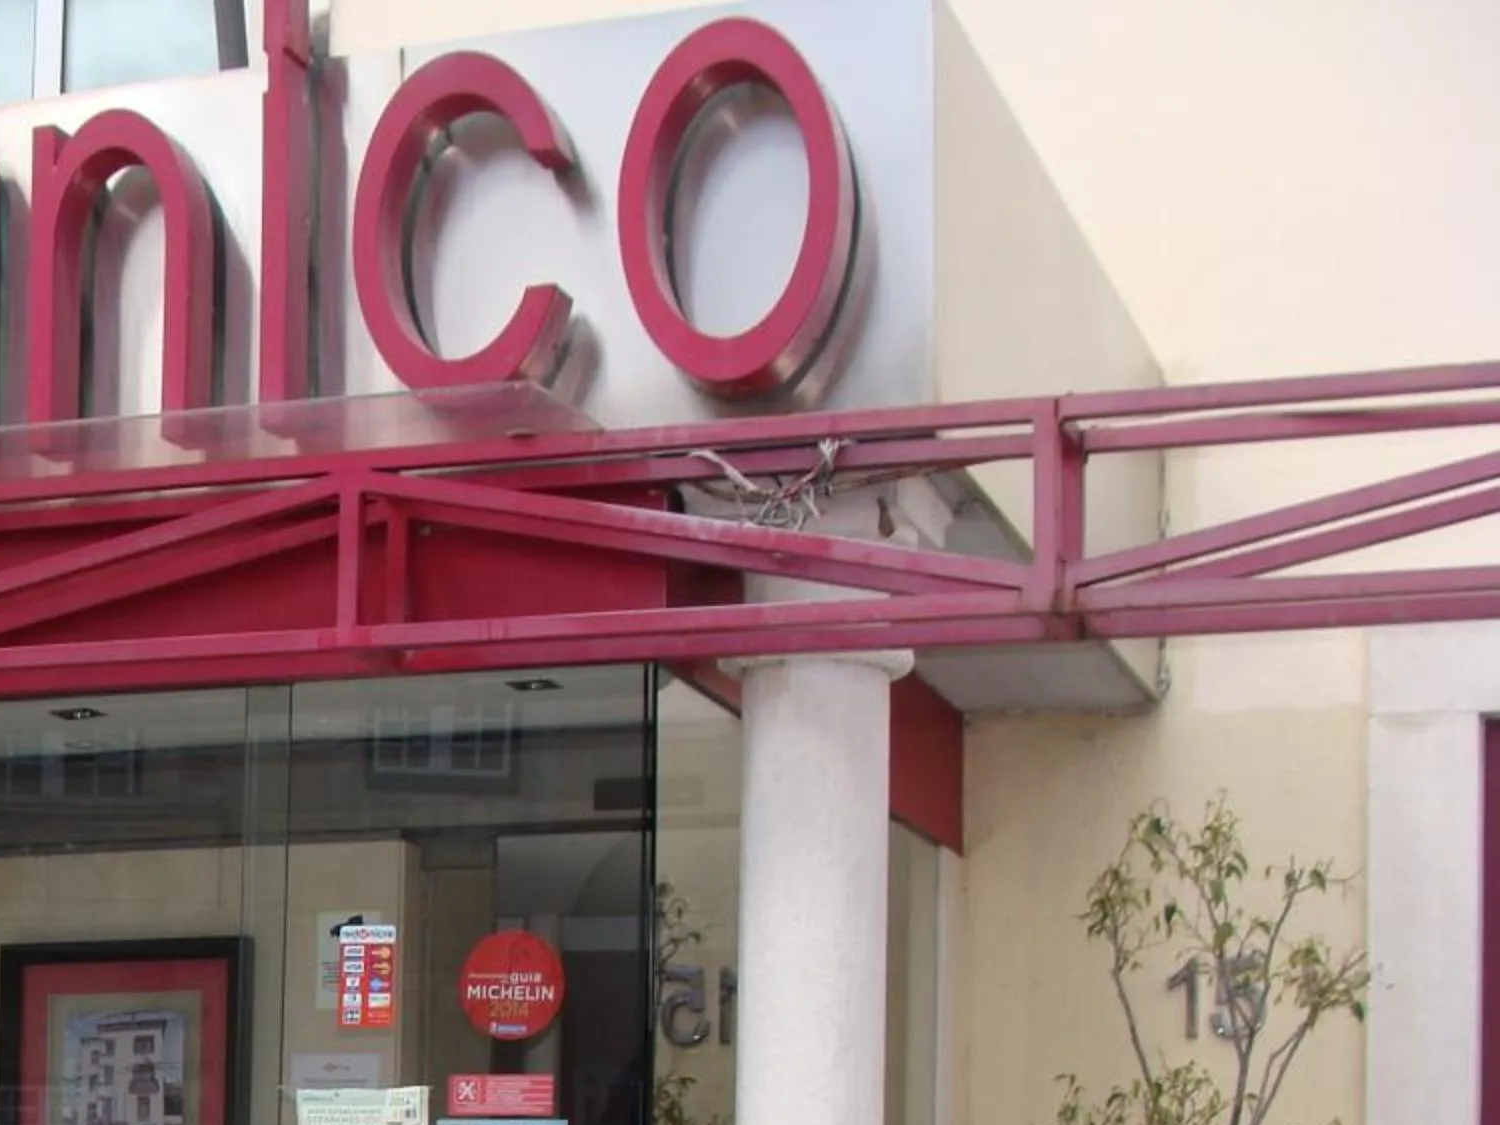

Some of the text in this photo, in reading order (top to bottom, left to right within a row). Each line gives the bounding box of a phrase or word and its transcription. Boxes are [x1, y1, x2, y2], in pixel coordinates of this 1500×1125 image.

[510, 971, 542, 985] guia
[467, 985, 555, 1001] MICHELIN
[1166, 951, 1269, 1041] 15
